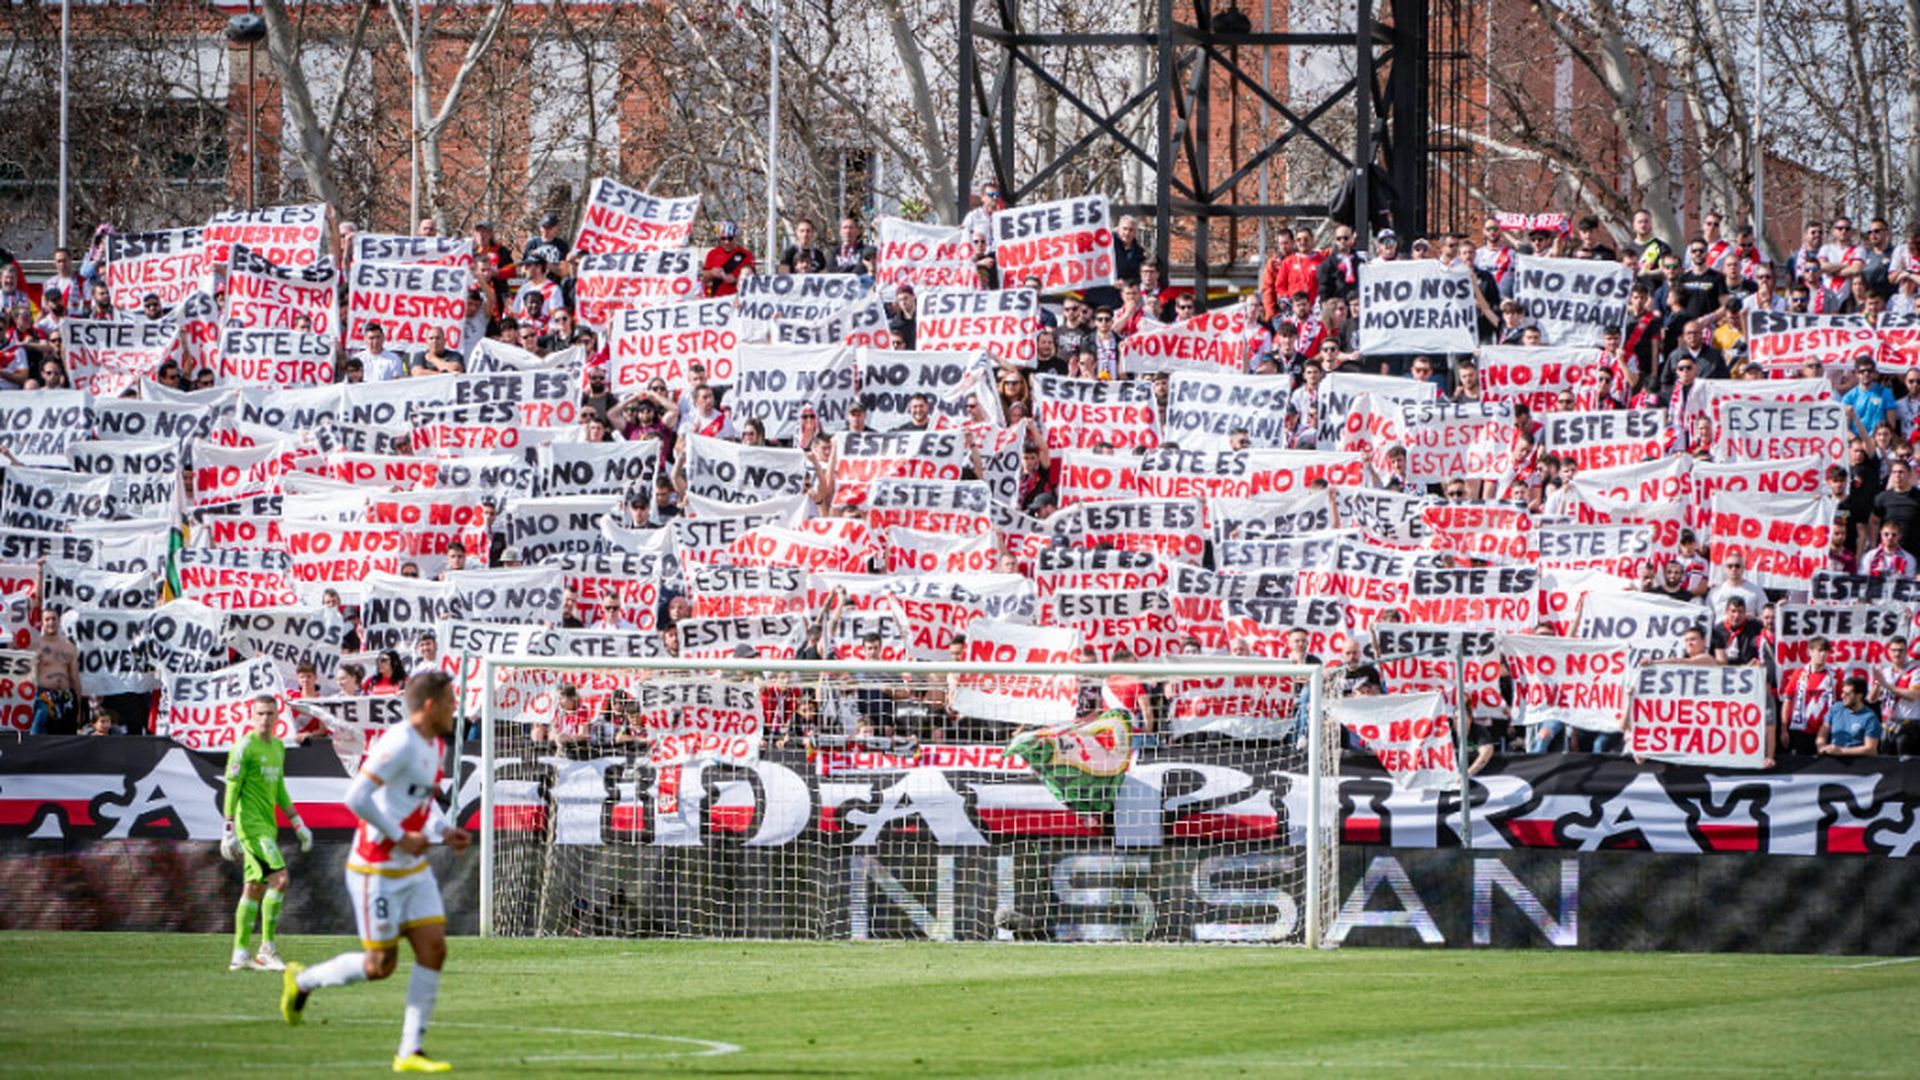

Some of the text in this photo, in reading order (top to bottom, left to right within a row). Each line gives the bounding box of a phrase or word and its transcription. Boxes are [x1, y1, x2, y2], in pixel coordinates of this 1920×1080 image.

[597, 179, 694, 221] ESTE ES
[1000, 201, 1103, 240] ESTE ES
[109, 233, 171, 261] ESTE
[202, 226, 319, 244] NUESTRO
[998, 228, 1112, 265] NUESTRO
[362, 239, 427, 260] ESTE
[583, 252, 690, 272] ESTE ES
[234, 244, 334, 282] ESTE ES
[228, 274, 333, 308] NUESTRO
[359, 264, 464, 292] ESTE ES
[577, 277, 692, 299] NUESTRO
[802, 278, 862, 299] NOS
[1571, 274, 1629, 299] NOS
[351, 292, 466, 321] NUESTRO
[922, 291, 1032, 316] ESTE ES
[1364, 279, 1471, 308] ¡NO NOS
[624, 307, 688, 331] ESTE
[700, 301, 731, 326] ES
[1364, 304, 1475, 332] MOVERÁN!
[69, 325, 133, 346] ESTE
[143, 325, 176, 347] ES
[228, 332, 291, 354] ESTE
[300, 332, 331, 354] ES
[619, 330, 737, 357] NUESTRO
[1749, 330, 1873, 356] NUESTRO
[1123, 333, 1245, 369] MOVERÁN!
[220, 357, 334, 383] NUESTRO
[738, 370, 851, 395] ¡NO NOS
[1481, 364, 1596, 388] ¡NO NOS
[457, 375, 567, 404] ESTE ES
[1041, 378, 1153, 403] ESTE ES
[1231, 385, 1288, 410] NOS
[39, 406, 97, 430] NOS
[154, 411, 209, 437] NOS
[478, 402, 514, 425] ES
[1042, 402, 1156, 425] NUESTRO
[1403, 400, 1468, 428] ESTE
[1729, 408, 1839, 433] ESTE ES
[1047, 426, 1160, 452] ESTADIO
[1552, 411, 1658, 443] ESTE ES
[845, 435, 956, 456] ESTE ES
[1727, 437, 1841, 461] NUESTRO
[124, 453, 176, 475] NOS
[385, 463, 438, 487] NOS
[481, 464, 533, 489] NOS
[543, 456, 656, 492] ¡NO NOS
[838, 459, 963, 483] NUESTRO
[1142, 452, 1249, 479] ESTE ES
[1411, 452, 1510, 478] ESTADIO
[745, 465, 806, 493] NOS
[1062, 467, 1112, 492] ¡NO
[1137, 476, 1251, 499] NUESTRO
[1641, 473, 1692, 502] NOS
[1759, 469, 1820, 494] NOS
[62, 494, 117, 518] NOS
[873, 484, 989, 512] ESTE ES
[429, 503, 485, 527] NOS
[1088, 507, 1195, 531] ESTE ES
[508, 514, 560, 545] ¡NO
[1769, 520, 1830, 549] NOS
[63, 538, 93, 561] ES
[340, 533, 398, 554] NOS
[1220, 543, 1335, 568] ESTE ES
[1540, 531, 1650, 558] ESTE ES
[260, 550, 290, 571] ES
[624, 556, 656, 577] ES
[890, 547, 999, 576] ¡NO NOS
[1040, 552, 1107, 573] ESTE
[1339, 548, 1404, 578] ESTE
[44, 577, 158, 608] ¡NO NOS
[696, 569, 802, 592] ESTE ES
[1178, 572, 1245, 597] ESTE
[1414, 570, 1537, 598] ESTE ES
[1812, 574, 1886, 601] ESTE
[363, 599, 411, 627] ¡NO
[506, 589, 563, 611] NOS
[692, 595, 806, 618] NUESTRO
[1060, 591, 1171, 618] ESTE ES
[1229, 600, 1342, 626] ESTE ES
[1410, 599, 1531, 625] NUESTRO
[285, 615, 342, 647] NOS
[684, 617, 793, 647] ESTE ES
[1582, 617, 1638, 640] ¡NO
[1783, 611, 1896, 637] ESTE ES
[450, 627, 561, 656] ESTE ES
[628, 635, 661, 658] ES
[1380, 631, 1495, 658] ESTE ES
[1510, 652, 1625, 679] ¡NO NOS
[174, 661, 275, 703] ESTE ES
[1640, 670, 1755, 695] ESTE ES
[643, 686, 712, 706] ESTE
[725, 685, 754, 709] ES
[1515, 677, 1623, 719] MOVERÁN!
[372, 700, 403, 725] ES
[640, 707, 757, 733] NUESTRO
[1634, 698, 1762, 728] NUESTRO
[1389, 715, 1448, 743] NOS
[1634, 727, 1760, 753] ESTADIO
[849, 855, 1580, 946] NISSAN
